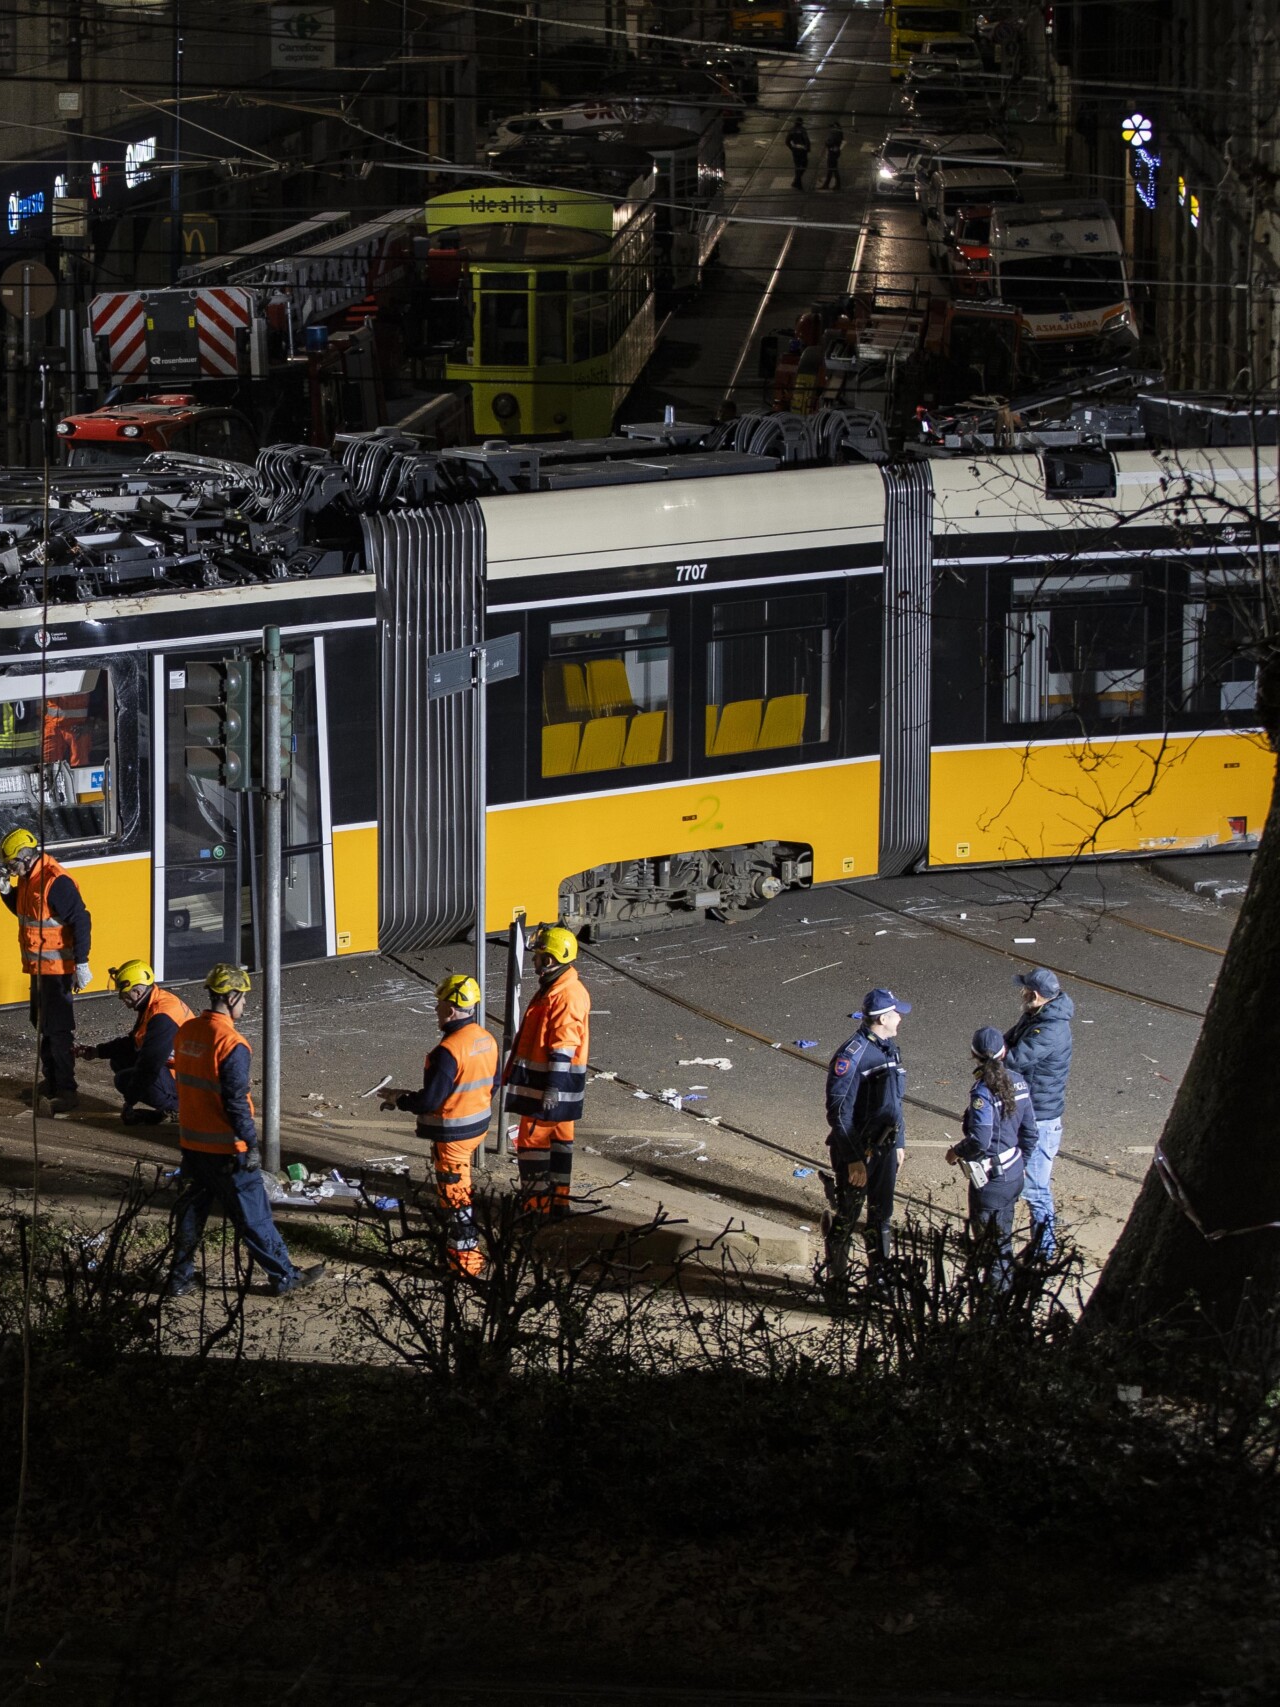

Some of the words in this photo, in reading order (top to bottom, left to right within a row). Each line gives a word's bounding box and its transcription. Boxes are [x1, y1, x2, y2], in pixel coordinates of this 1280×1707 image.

[470, 195, 557, 213] idealista
[162, 356, 197, 365] rosenbauer
[676, 564, 707, 581] 7707
